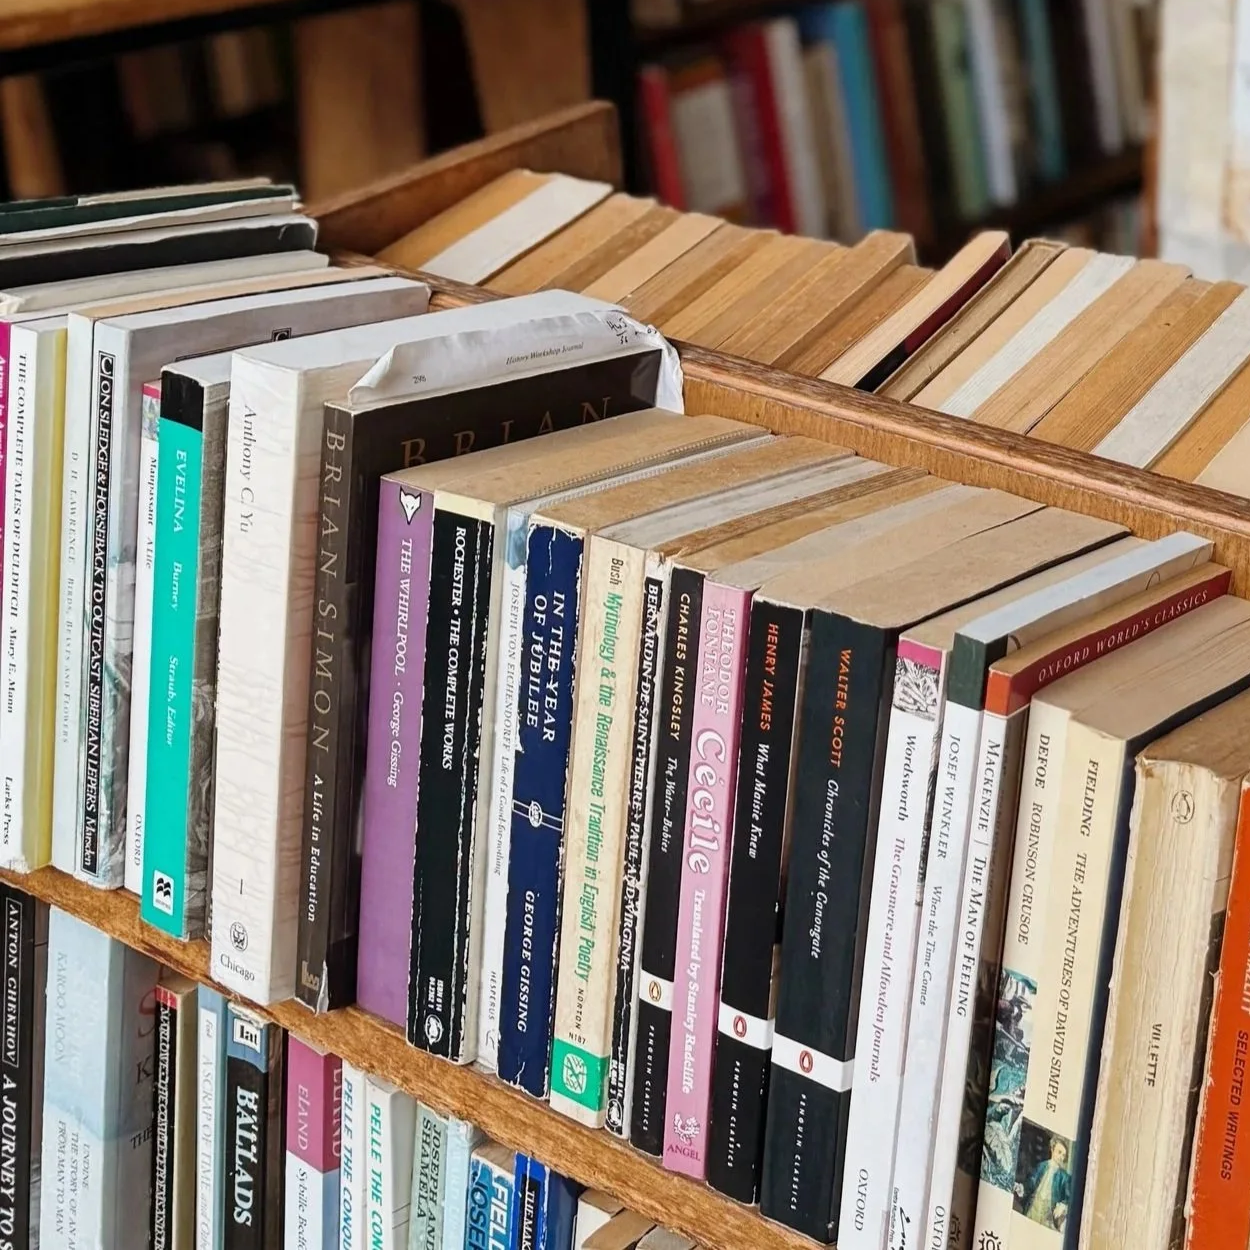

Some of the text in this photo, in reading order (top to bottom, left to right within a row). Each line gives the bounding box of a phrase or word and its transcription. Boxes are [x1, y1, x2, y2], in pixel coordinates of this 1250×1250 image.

[506, 342, 584, 365] History Workshop Journal
[147, 457, 157, 525] Maupassant
[239, 404, 257, 480] Anthony
[68, 489, 78, 564] LAWRENCE
[3, 353, 28, 845] THE COMPLETE TALES DULDITCH Mary Mann Larks Press
[165, 449, 188, 748] EVELINA Burney Editor
[442, 526, 467, 771] ROCHESTER THE COMPLETE WORKS
[701, 606, 721, 706] FONTANE
[1038, 590, 1208, 683] OXFORD CLASSICS
[86, 605, 103, 812] OUTCAST SIBERIAN LEPERS
[307, 429, 346, 922] BRIAN SIMON Life Education
[387, 538, 412, 788] THE WHIRLPOOL George Gissing
[501, 581, 520, 751] JOSEPH VON EICHENDORFF
[526, 595, 547, 728] OF JUBILEE
[542, 592, 565, 742] IN THE YEAR
[716, 609, 736, 714] THEODOR
[574, 557, 624, 983] Bush Mythology the Renaissance Tradition English Poetry
[661, 592, 691, 853] CHARLES KINGSLEY Water-Babies
[748, 622, 779, 859] HENRY JAMES What Maisie Knew
[688, 728, 726, 875] Cécile
[809, 648, 852, 959] WALTER SCOTT Chronicles Canongate
[1017, 733, 1050, 946] DEFOE ROBINSON CRUSOE
[869, 734, 917, 1083] Wordsworth The Grasmere Journals
[919, 734, 961, 1006] JOSEF WINKLER When Time Comes
[956, 739, 1001, 1018] MACKENZIE THE MAN FEELING
[220, 953, 256, 982] Chicago
[516, 890, 536, 1033] GEORGE GISSING
[682, 889, 706, 1094] Translated Stanley Radcliffe
[1045, 758, 1099, 1113] FIELDING THE ADVENTURES OF DAVID SIMPLE
[0, 905, 19, 1203] ANTON CHEKHOV JOURNEY
[488, 971, 498, 1020] HESPERUS
[568, 1031, 587, 1046] N187
[575, 988, 585, 1030] NORTON
[297, 1084, 309, 1150] ELAND
[642, 1025, 655, 1131] PENGUIN CLASSICS
[727, 1060, 741, 1168] PENGUIN CLASSICS
[1229, 1030, 1249, 1105] SELECTED
[69, 1157, 79, 1194] STORY
[82, 1143, 91, 1190] UNDINE
[200, 1068, 213, 1191] SCRAP TIME
[233, 1086, 257, 1227] BALLADS
[343, 1078, 353, 1182] PELLE THE
[370, 1102, 383, 1207] PELLE THE
[417, 1117, 431, 1219] SHAMELA
[427, 1124, 442, 1206] JOSEPH
[666, 1143, 701, 1161] ANGEL
[790, 1093, 807, 1210] PENGUIN CLASSICS
[1220, 1111, 1240, 1181] WRITINGS
[854, 1168, 869, 1232] OXFORD
